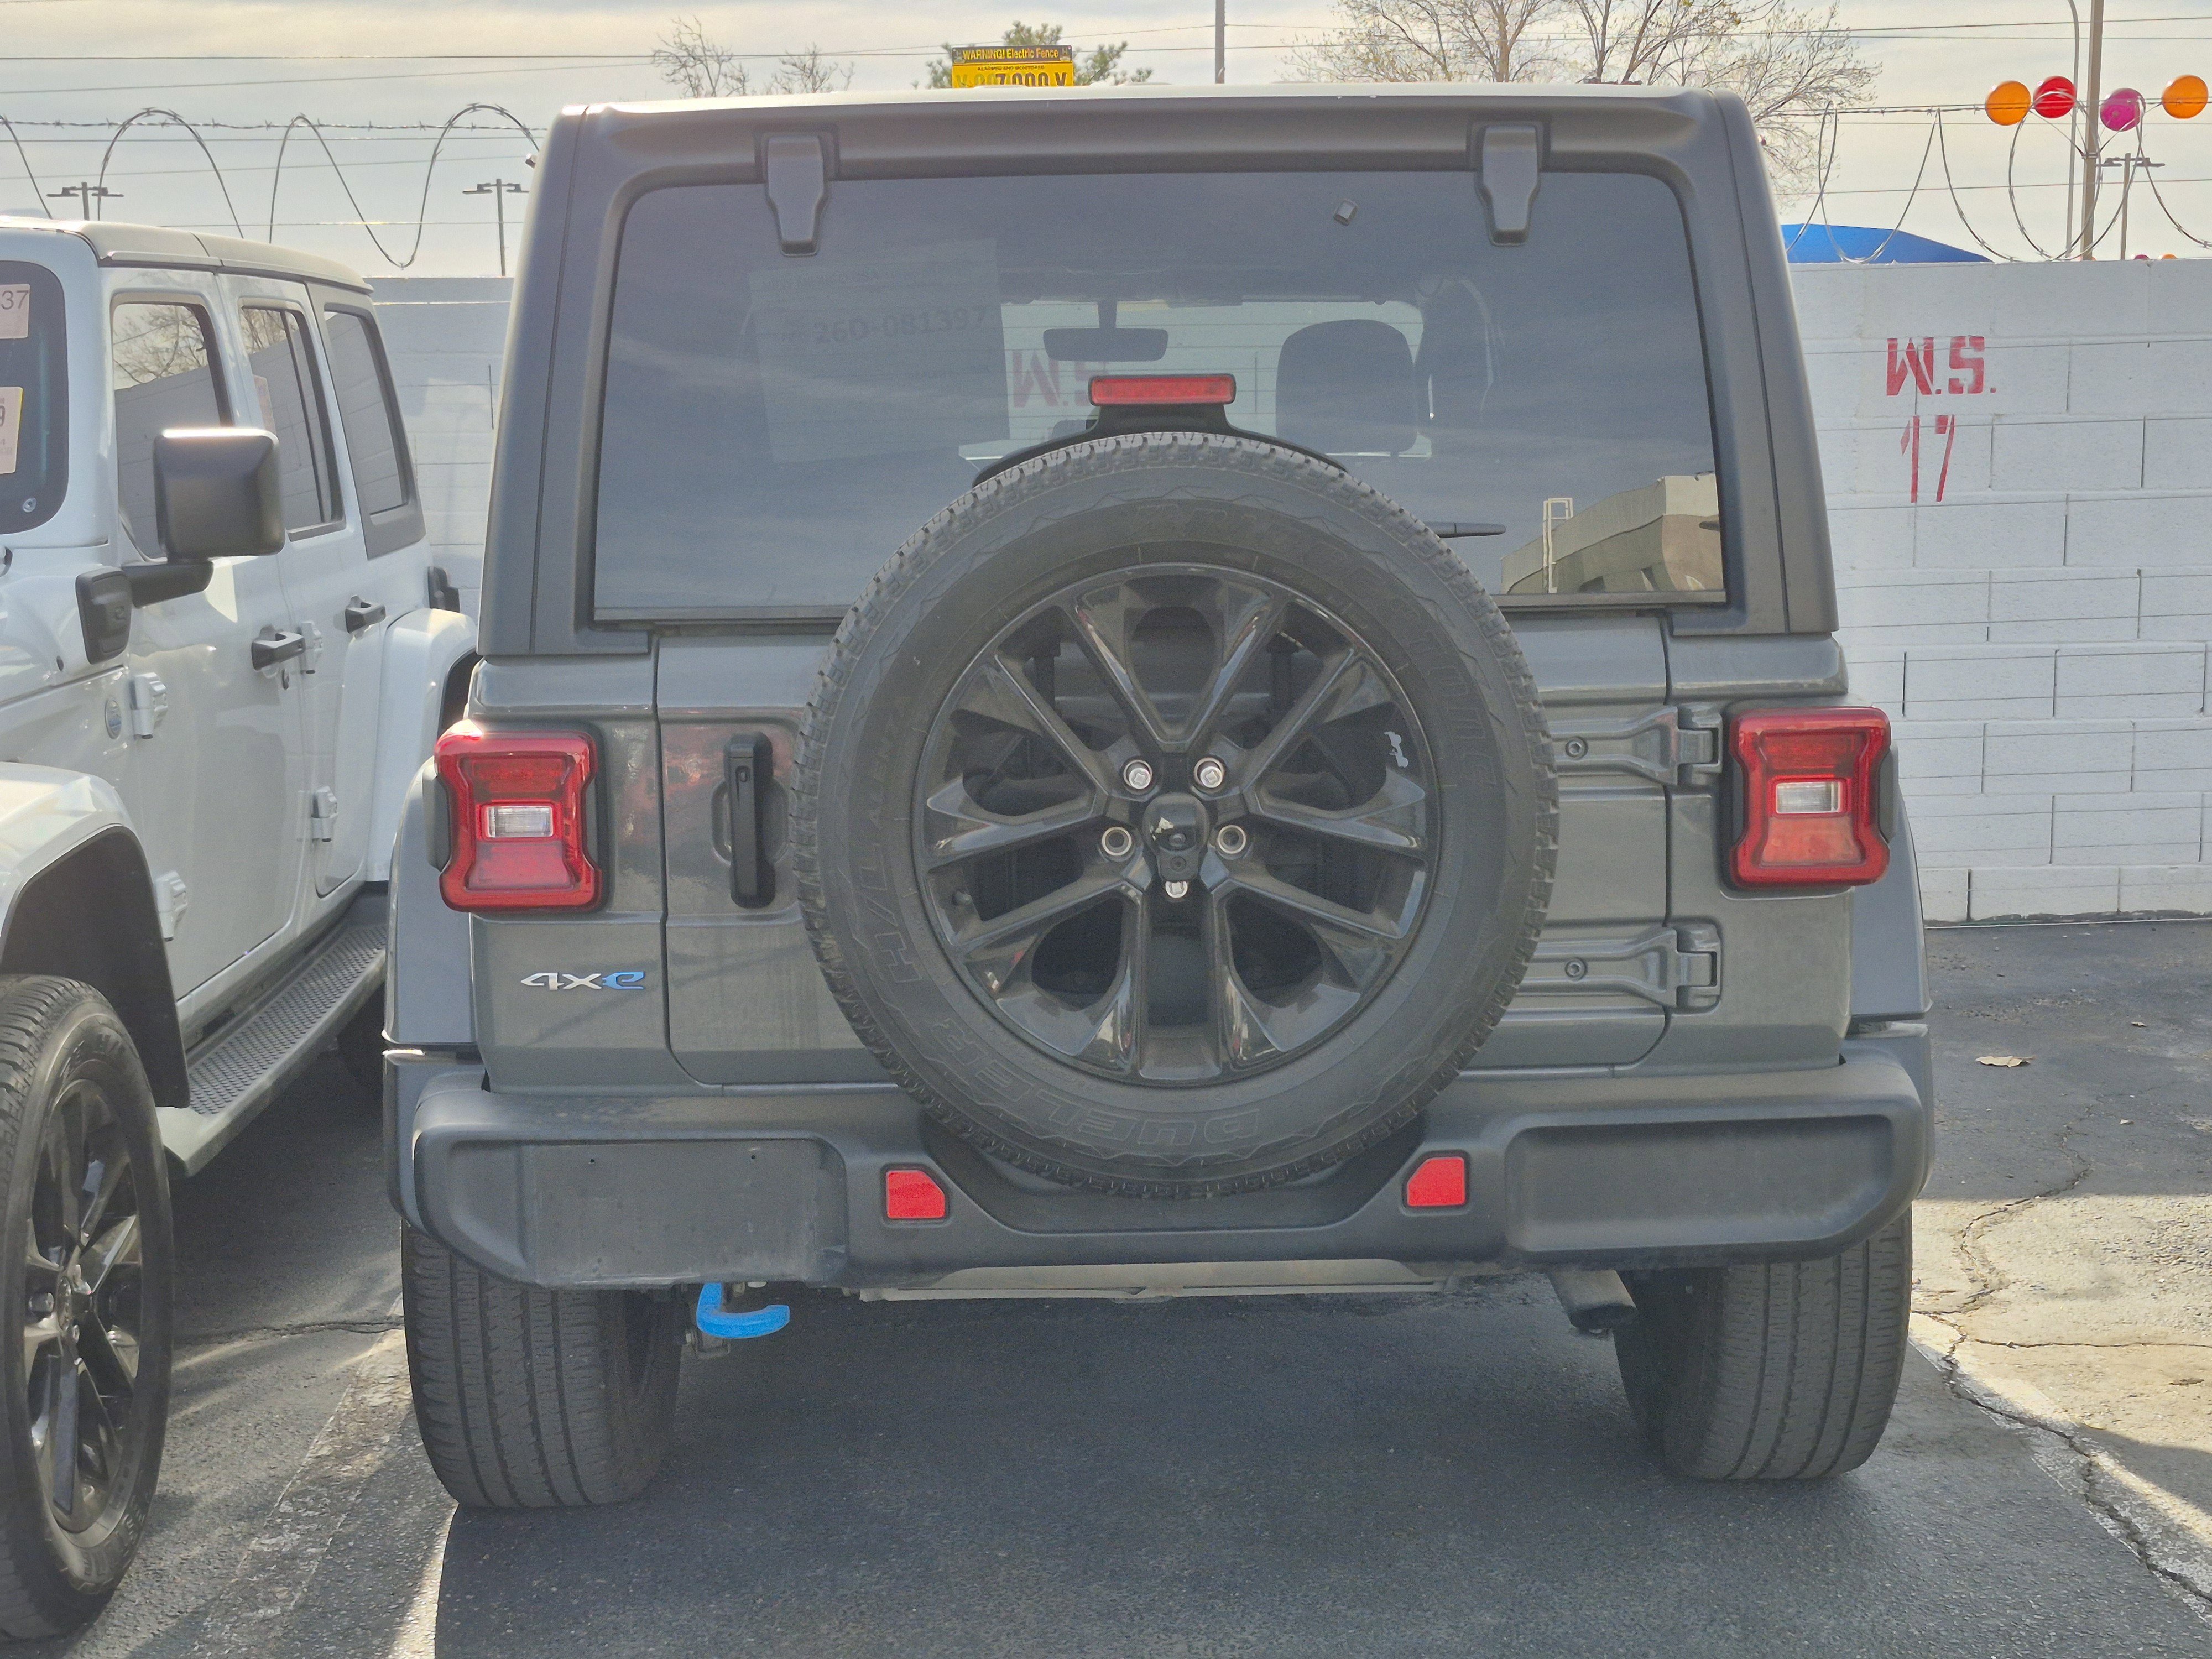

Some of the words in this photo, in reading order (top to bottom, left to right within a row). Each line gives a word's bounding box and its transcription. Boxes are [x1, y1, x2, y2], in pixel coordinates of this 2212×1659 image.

[962, 48, 1005, 60] WARNING!
[1006, 48, 1034, 59] Electric
[1036, 48, 1058, 58] Fence
[1900, 414, 1955, 503] 17
[854, 841, 924, 992] H/L
[928, 1013, 1265, 1146] DUELER
